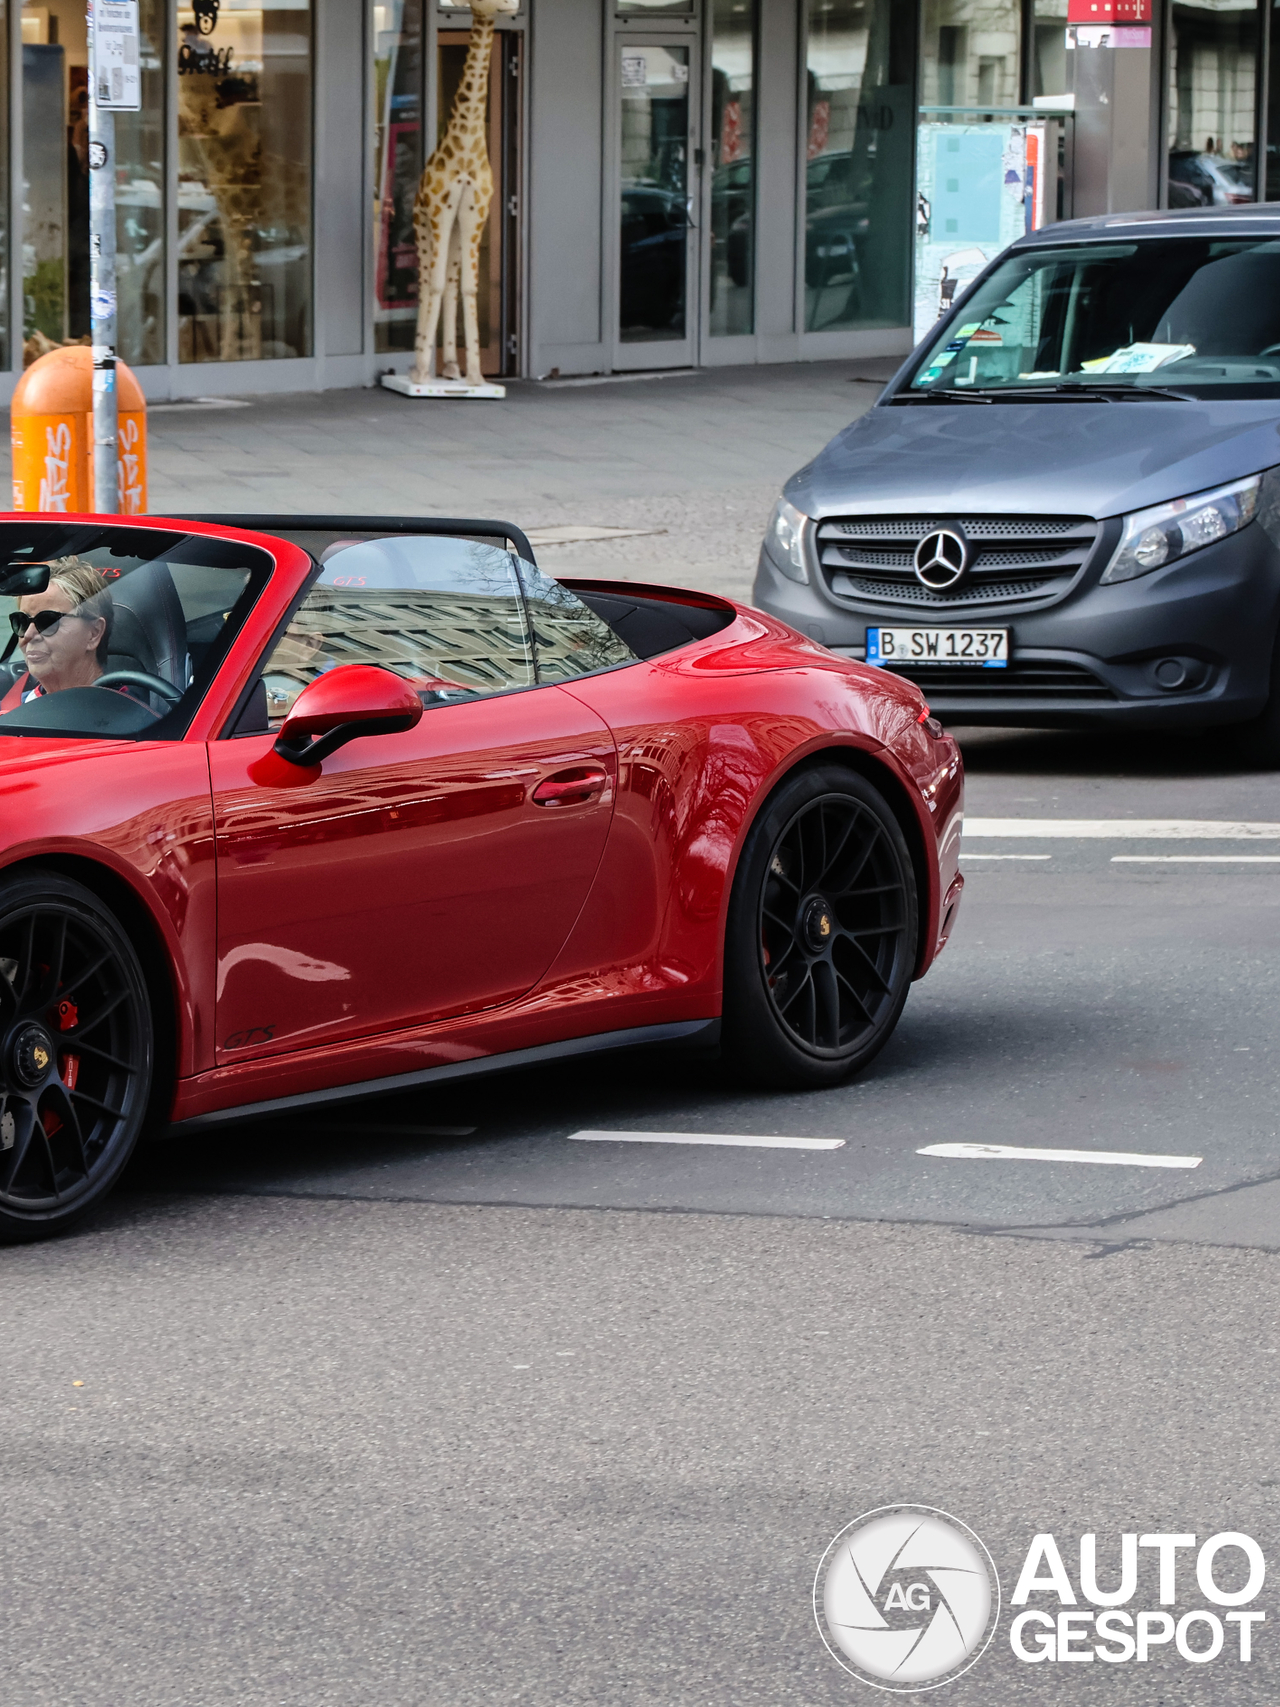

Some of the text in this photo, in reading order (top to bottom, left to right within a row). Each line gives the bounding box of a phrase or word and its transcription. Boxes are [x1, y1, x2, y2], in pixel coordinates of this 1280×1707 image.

[95, 567, 122, 578] TS
[333, 576, 367, 586] GTS
[882, 632, 1003, 657] B SW 1237
[224, 1024, 276, 1050] GTS
